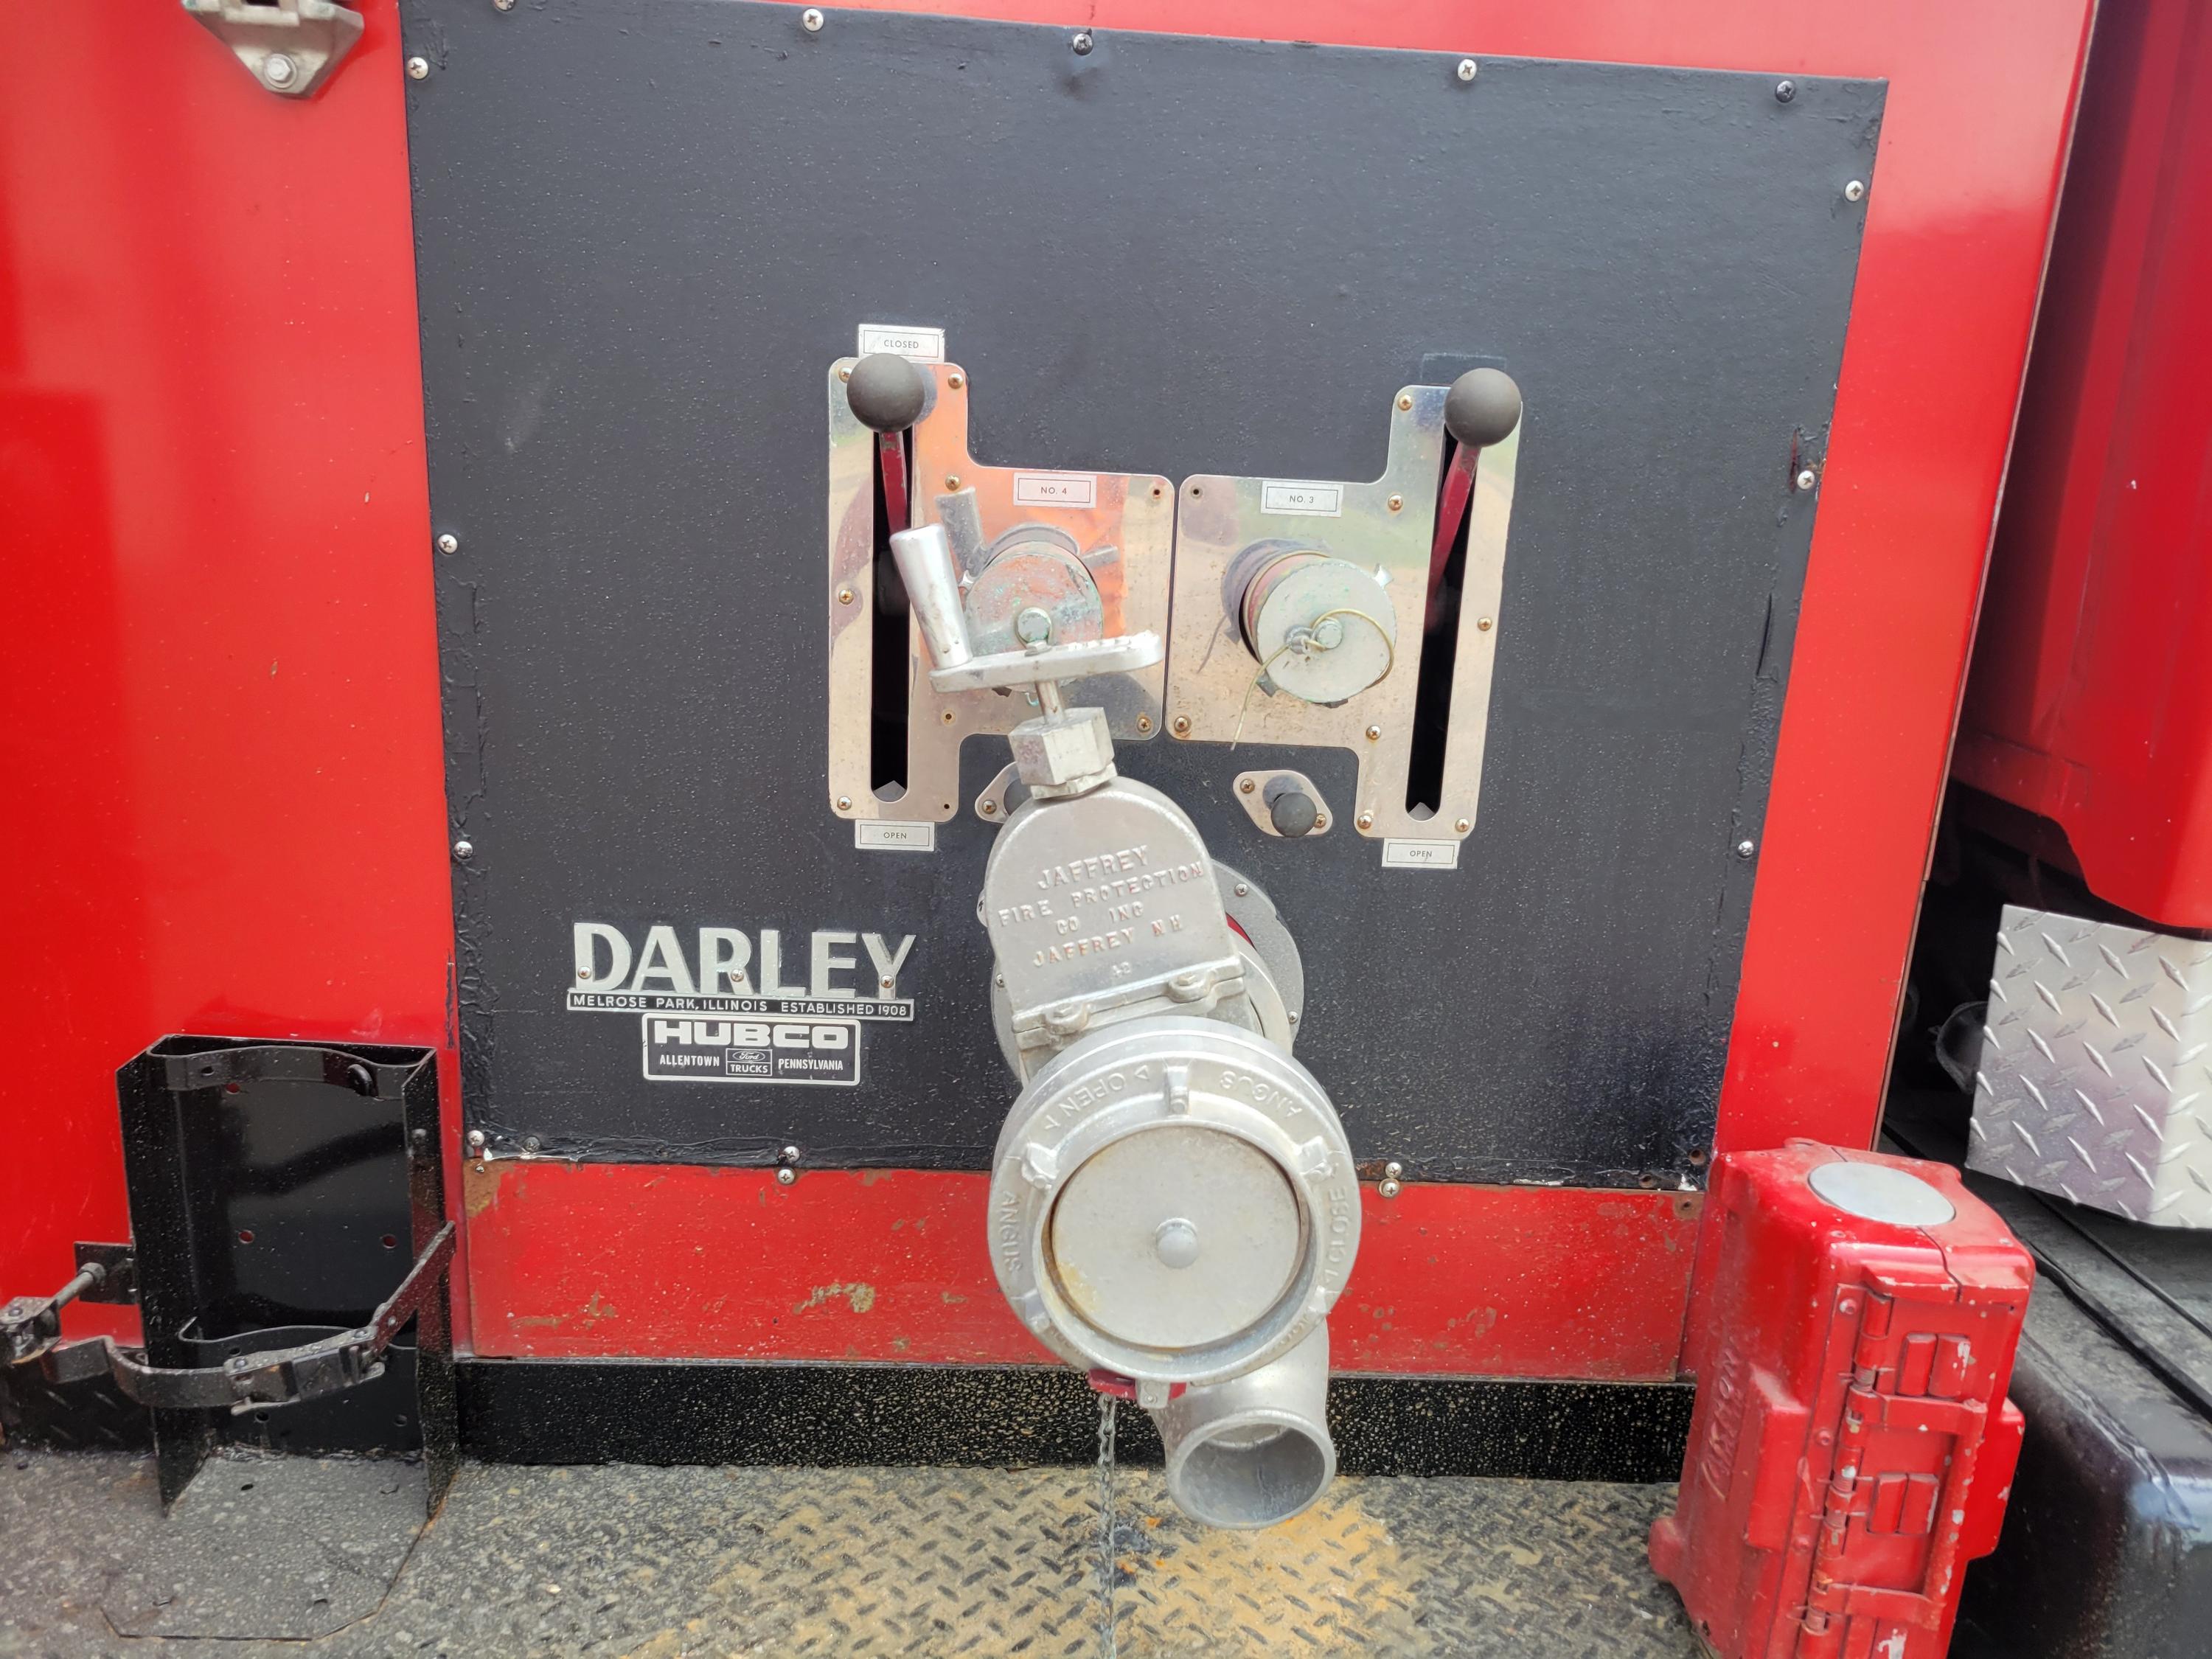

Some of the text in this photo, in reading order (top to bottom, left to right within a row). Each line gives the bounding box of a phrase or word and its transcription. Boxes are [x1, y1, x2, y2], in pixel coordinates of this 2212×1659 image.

[884, 339, 919, 349] CLOSED
[1290, 495, 1305, 503] NO.
[1037, 845, 1150, 890] JAFFREY
[998, 861, 1204, 927] FIRE PROTECTION
[1056, 901, 1144, 935] CO INC
[574, 922, 917, 999] DARLEY
[1033, 928, 1135, 967] JAFFREY
[574, 994, 907, 1016] MELROSE PARK, ILLINOIS ESTABLISHED 1908
[654, 1020, 849, 1049] HUBCO
[660, 1054, 720, 1067] ALLENTOWN
[730, 1063, 768, 1074] TRUCKS
[739, 1052, 759, 1060] Ford
[778, 1058, 844, 1071] PENNSYLVANIA
[1062, 1072, 1127, 1118] OPEN
[1220, 1071, 1304, 1119] ANGUS
[1001, 1189, 1023, 1273] ANGUS
[1328, 1184, 1352, 1265] CLOSE
